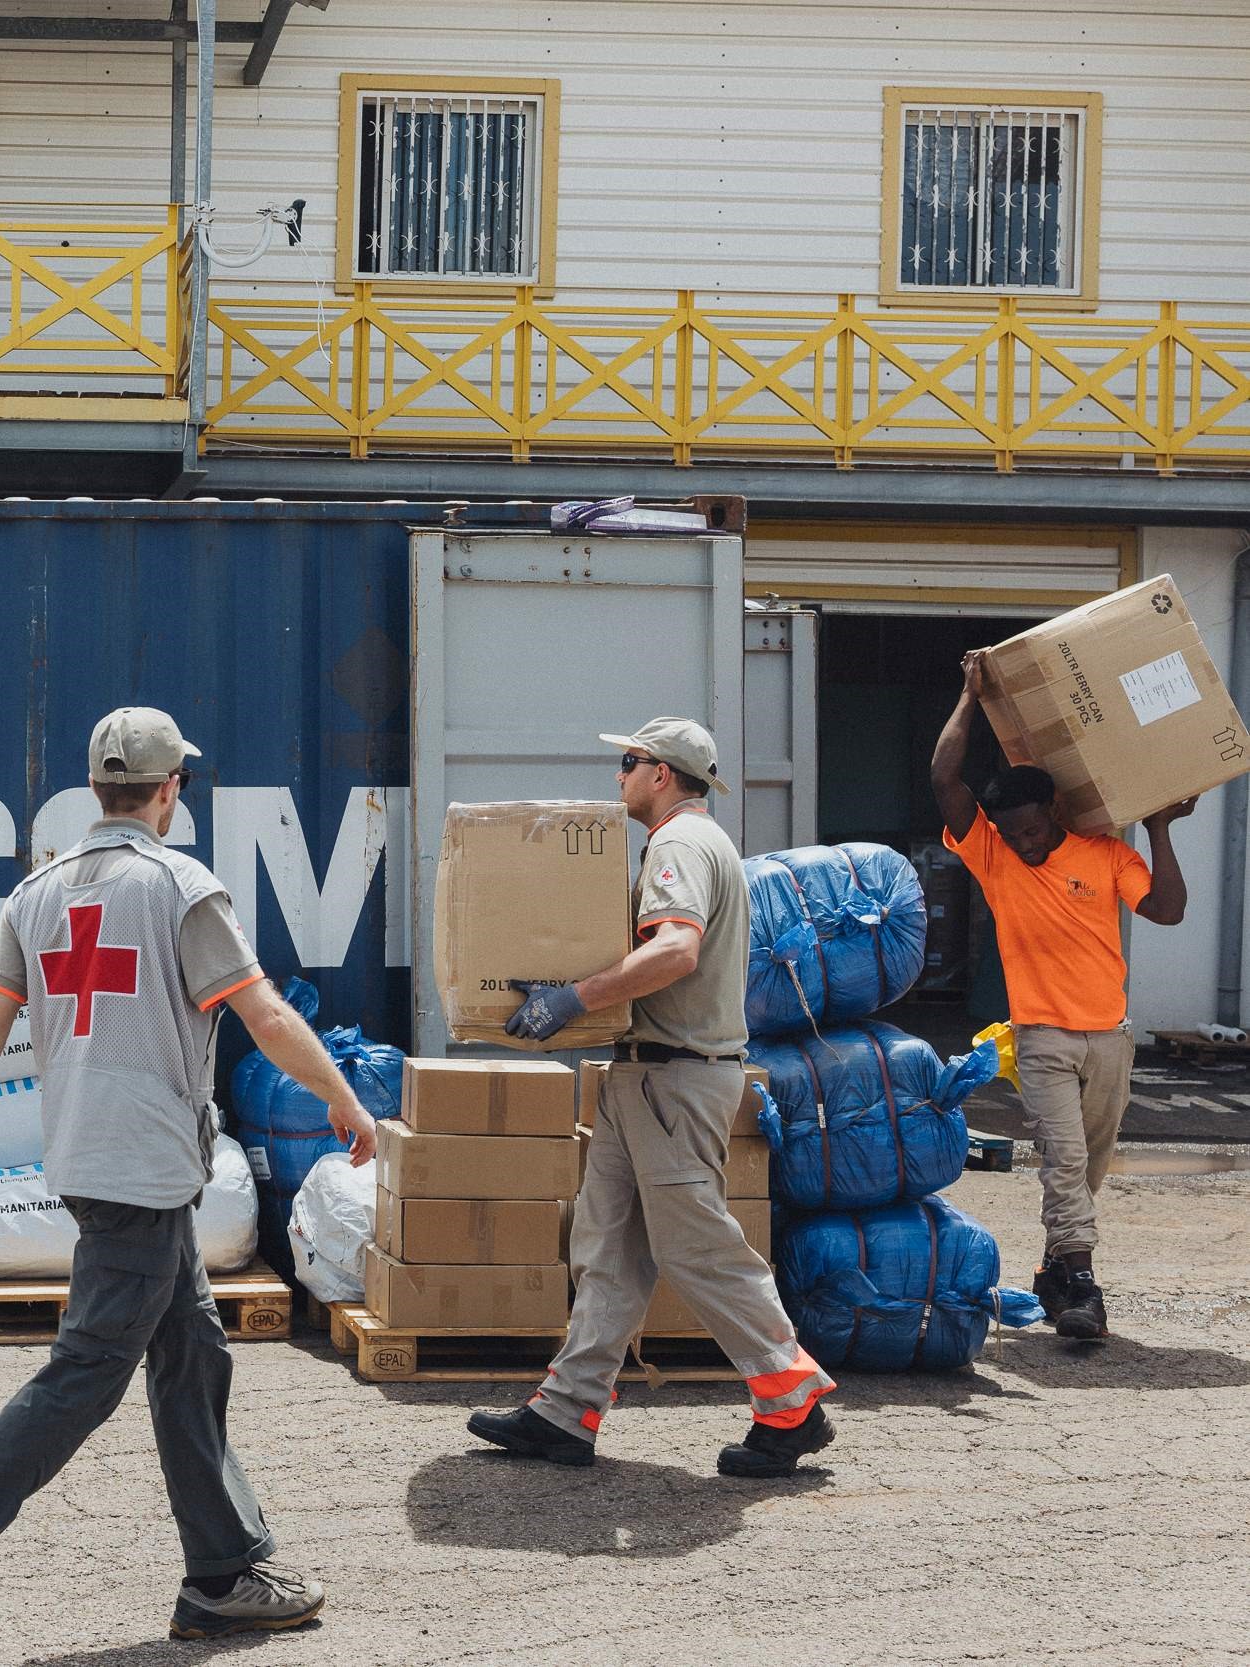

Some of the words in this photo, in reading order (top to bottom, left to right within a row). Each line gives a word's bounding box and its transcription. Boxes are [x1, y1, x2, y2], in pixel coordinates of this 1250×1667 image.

[1058, 641, 1079, 671] 20LTR
[1073, 671, 1094, 699] JERRY
[1089, 701, 1105, 723] CAN
[1070, 691, 1082, 705] 30
[1076, 705, 1092, 727] PCS.
[480, 979, 510, 991] 20LT
[253, 1314, 277, 1327] EPAL
[379, 1353, 406, 1367] EPAL
